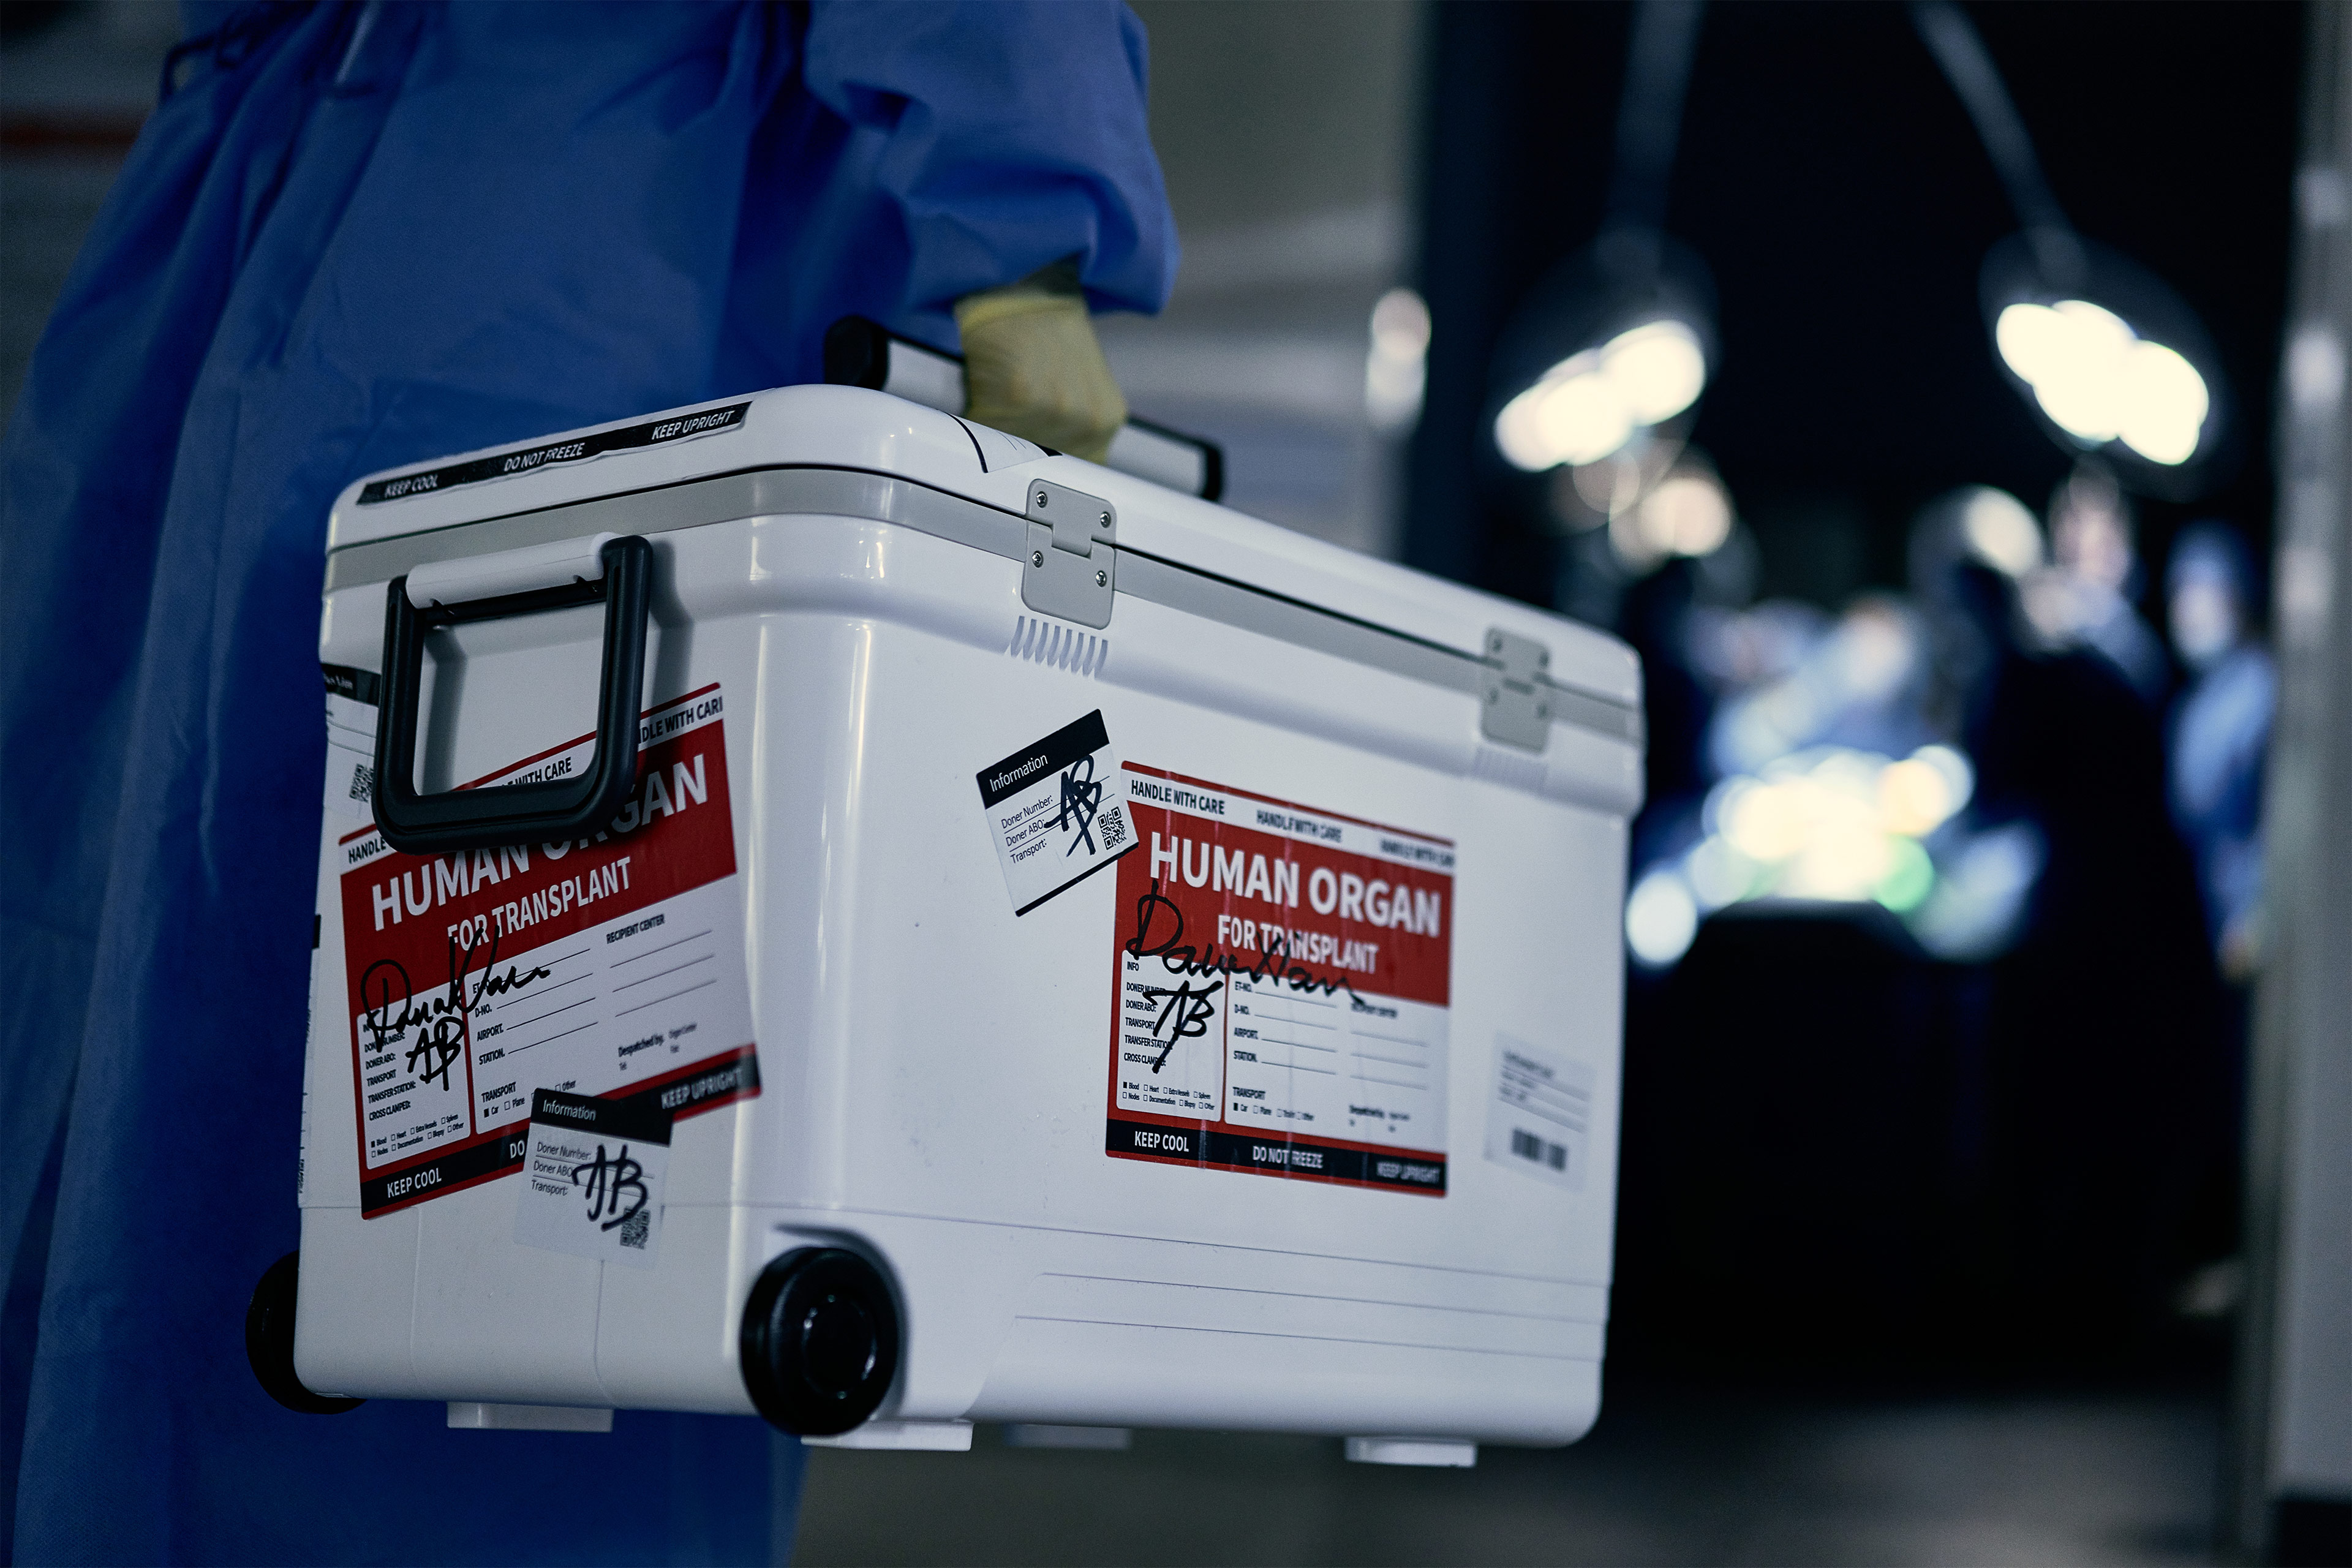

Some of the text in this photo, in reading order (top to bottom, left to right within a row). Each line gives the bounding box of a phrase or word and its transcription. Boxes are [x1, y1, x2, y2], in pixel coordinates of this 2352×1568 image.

[384, 410, 735, 498] KEEP COOL DO NOT FREEZE KEEP UPRIGHT
[989, 755, 1048, 793] Information
[349, 837, 386, 864] HANDLE
[545, 757, 572, 781] CARE
[665, 707, 694, 733] WITH
[1131, 780, 1172, 803] HANDLE
[1174, 789, 1196, 809] WITH
[1199, 796, 1225, 815] CARE
[1001, 795, 1053, 829] Doner Number:
[1006, 829, 1028, 847] Doner
[1011, 838, 1047, 864] Transport:
[372, 844, 529, 932] HUMAN
[1150, 831, 1300, 908] HUMAN
[1308, 867, 1441, 938] ORGAN
[448, 856, 631, 951] FOR TRANSPLANT
[606, 914, 665, 944] RECIPIENT CENTER
[1218, 914, 1376, 974] FOR TRANSPLANT
[1127, 961, 1139, 971] INFO
[1127, 982, 1144, 993] DONER
[475, 1003, 492, 1017] D-NO.
[1126, 1000, 1156, 1012] DONER ABO:
[477, 1023, 504, 1041] AIRPORT.
[1125, 1017, 1156, 1030] TRANSPORT
[1125, 1035, 1150, 1047] TRANSFER
[366, 1056, 383, 1070] DONER
[479, 1048, 505, 1065] STATION.
[1124, 1052, 1141, 1063] CROSS
[367, 1069, 396, 1087] TRANSPORT
[368, 1081, 416, 1103] TRANSFER STATION:
[481, 1082, 516, 1102] TRANSPORT
[1149, 1095, 1176, 1106] Documentation
[1232, 1086, 1266, 1101] TRANSPORT
[369, 1100, 411, 1121] CROSS CLAMPED:
[513, 1097, 525, 1109] Plane
[543, 1099, 597, 1121] Information
[386, 1068, 742, 1198] KEEP COOL DO KEEP UPRIGHT
[537, 1142, 591, 1161] Doner Number:
[1135, 1131, 1160, 1148] KEEP
[1163, 1134, 1189, 1152] COOL
[1253, 1145, 1267, 1161] DO
[1268, 1148, 1287, 1165] NOT
[1291, 1150, 1324, 1169] FREEZE
[533, 1160, 556, 1174] Doner
[531, 1180, 568, 1196] Transport:
